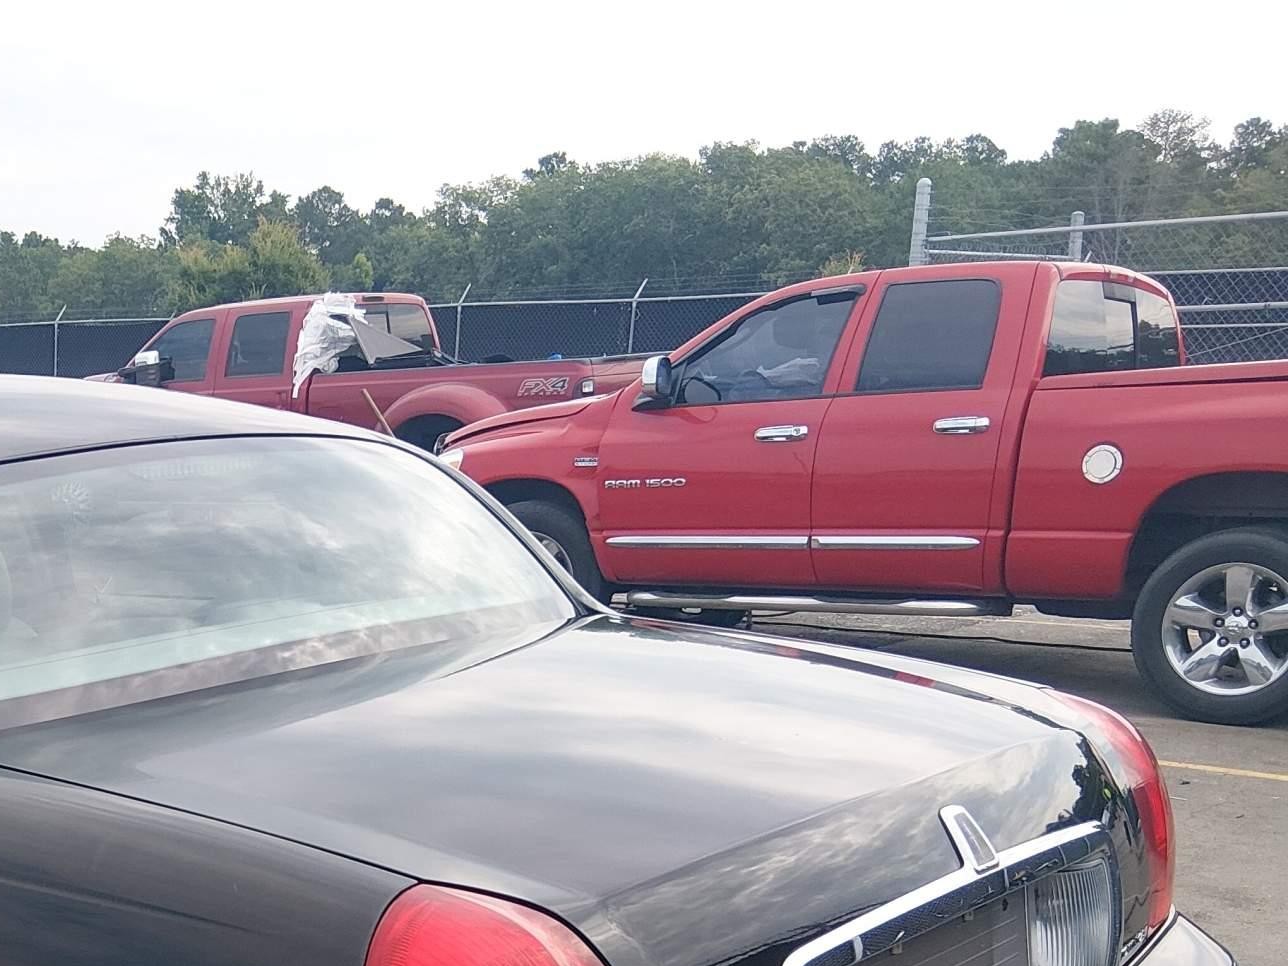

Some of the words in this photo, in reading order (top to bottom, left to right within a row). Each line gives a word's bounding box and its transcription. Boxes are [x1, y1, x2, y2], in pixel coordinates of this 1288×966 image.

[519, 377, 569, 393] FX4
[605, 479, 640, 488] RAM
[645, 478, 686, 488] 1500
